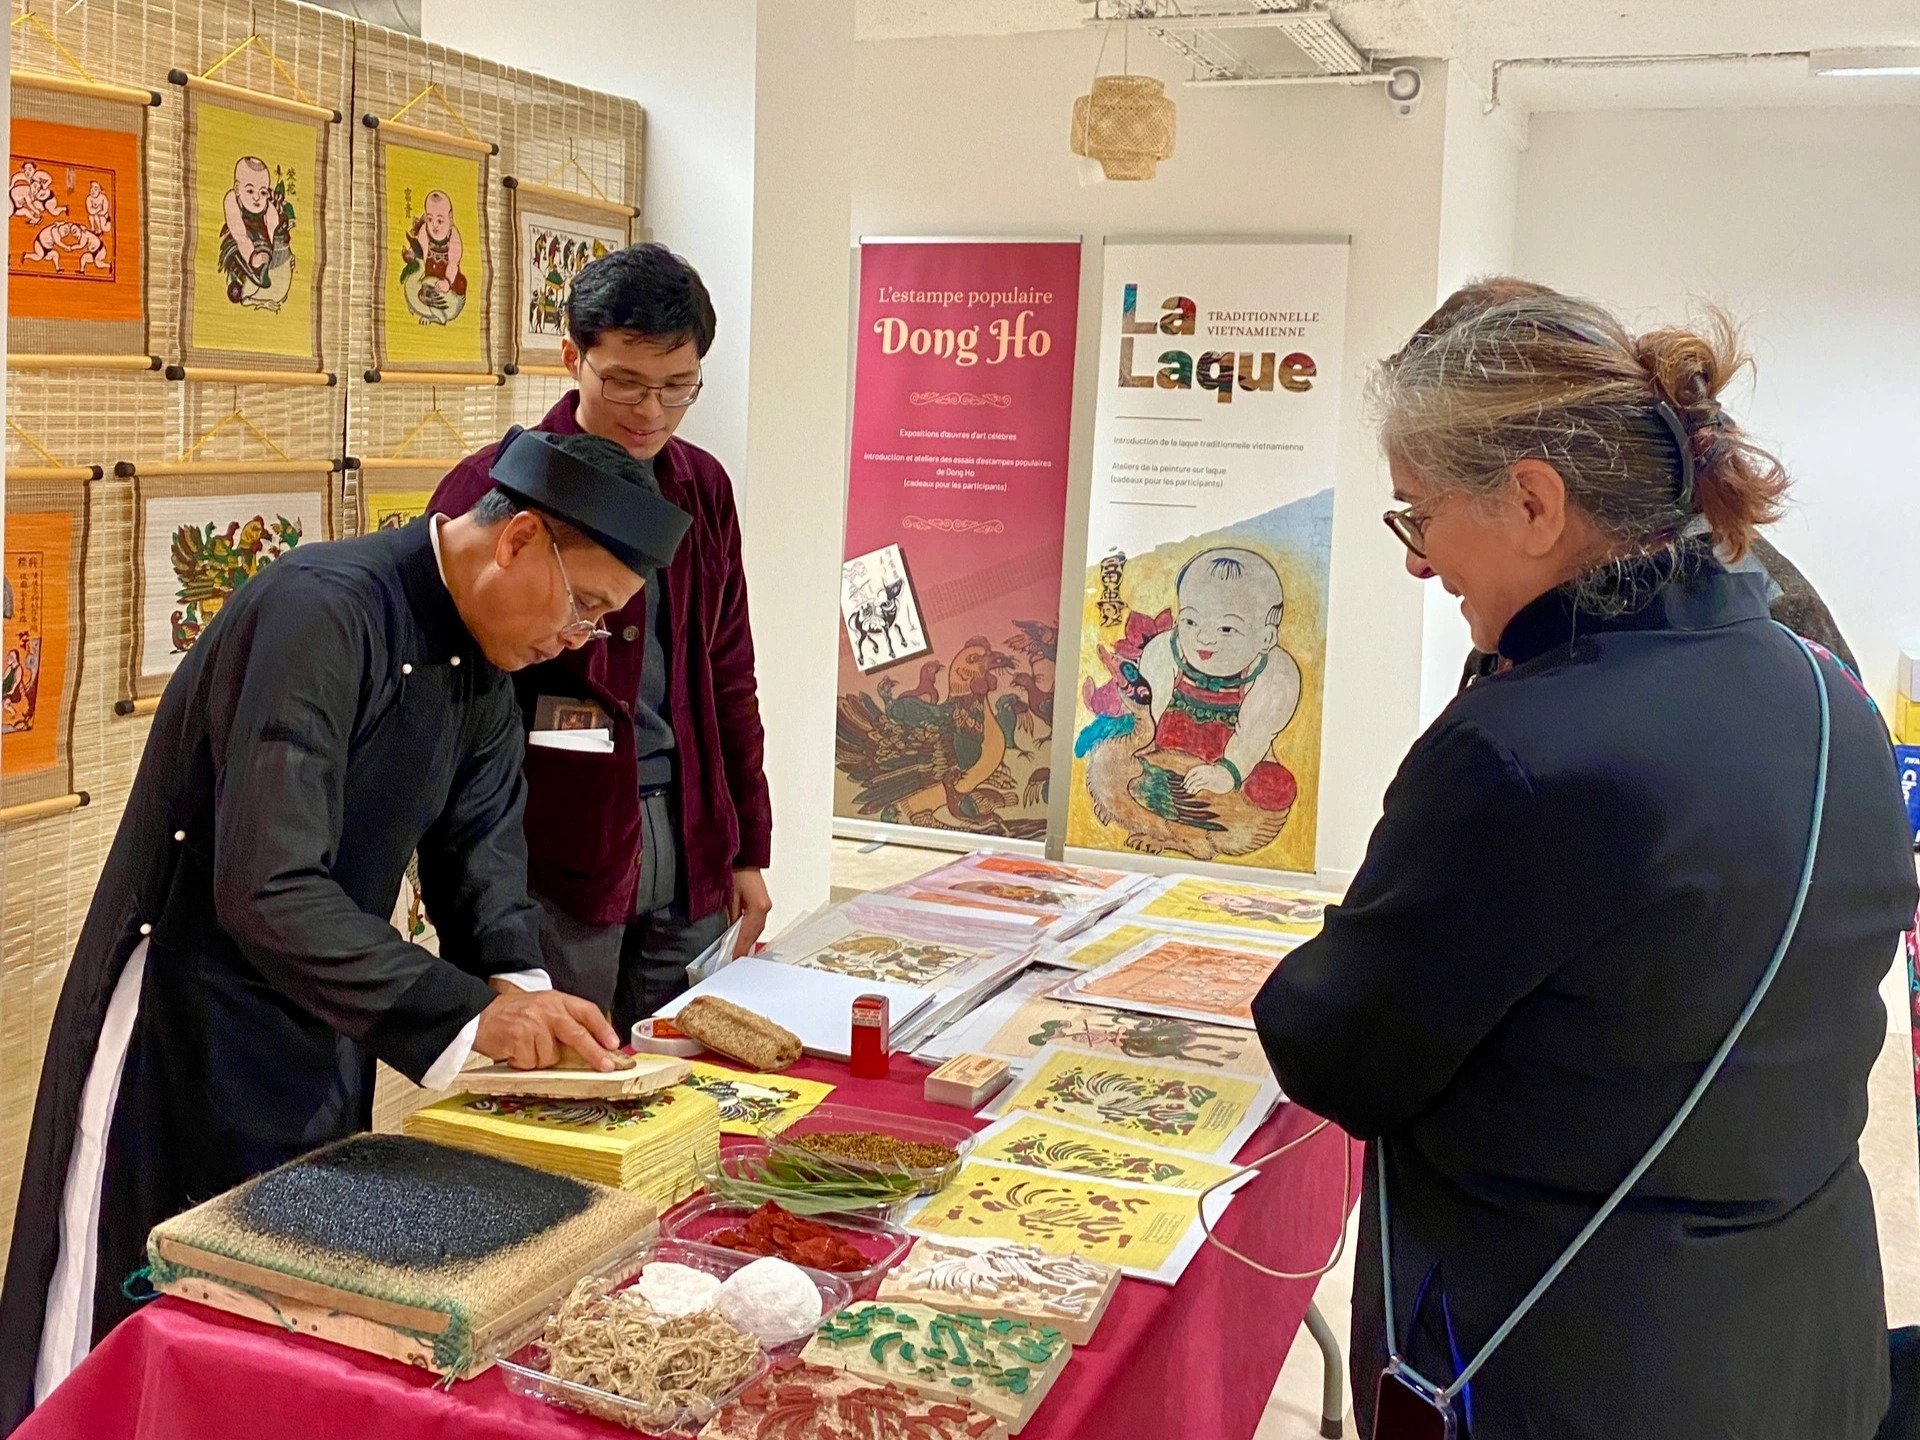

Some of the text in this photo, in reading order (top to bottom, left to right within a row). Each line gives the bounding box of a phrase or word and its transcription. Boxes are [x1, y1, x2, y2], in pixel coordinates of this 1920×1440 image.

[968, 286, 1053, 308] populaire
[1121, 283, 1197, 336] La
[1207, 311, 1320, 323] TRADITIONNELLE
[873, 310, 1051, 367] Dong Ho
[1207, 326, 1306, 338] VIETNAMIENNE
[1118, 336, 1318, 404] Laque
[899, 428, 939, 439] Expositions
[1113, 436, 1304, 452] Introduction de la laque traditionnelle vietnamienne
[864, 452, 905, 461] Introduction
[906, 454, 913, 462] et
[914, 455, 940, 463] ateliers
[940, 456, 952, 464] des
[953, 456, 975, 465] essais
[1014, 459, 1052, 468] populaires
[936, 468, 975, 478] de Dong Ho
[1112, 462, 1139, 471] Ateliers
[1140, 464, 1150, 472] de
[1151, 464, 1158, 472] la
[1159, 464, 1191, 474] peinture
[1205, 466, 1227, 475] laque
[903, 478, 1007, 492] (cadeaux pour les participants)
[1110, 474, 1223, 489] (cadeaux pour les participants)
